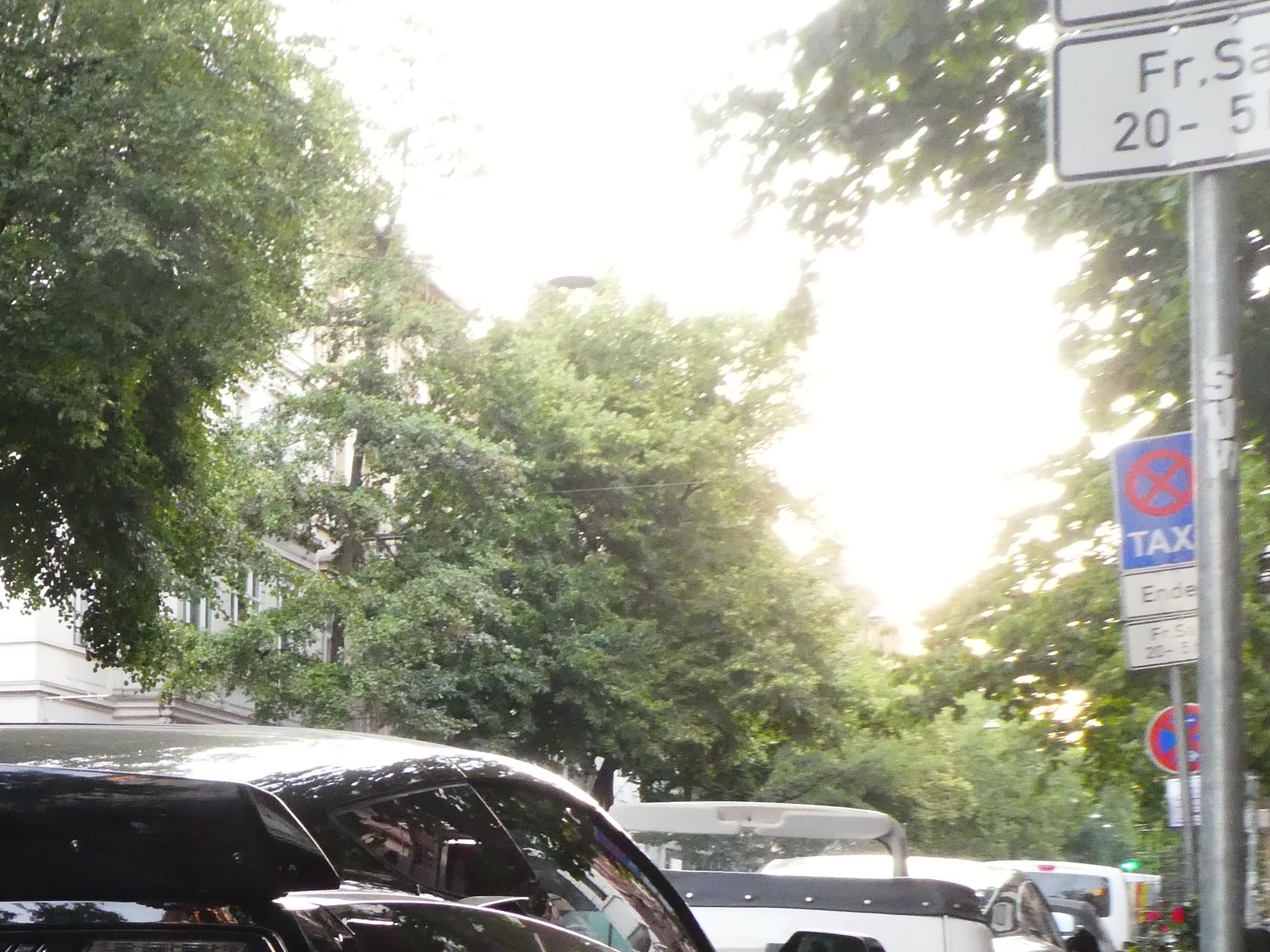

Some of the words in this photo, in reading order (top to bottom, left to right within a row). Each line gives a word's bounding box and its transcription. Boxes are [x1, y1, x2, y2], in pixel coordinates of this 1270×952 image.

[1230, 93, 1270, 135] 5
[1127, 525, 1195, 558] TAX
[1141, 582, 1196, 603] Ende
